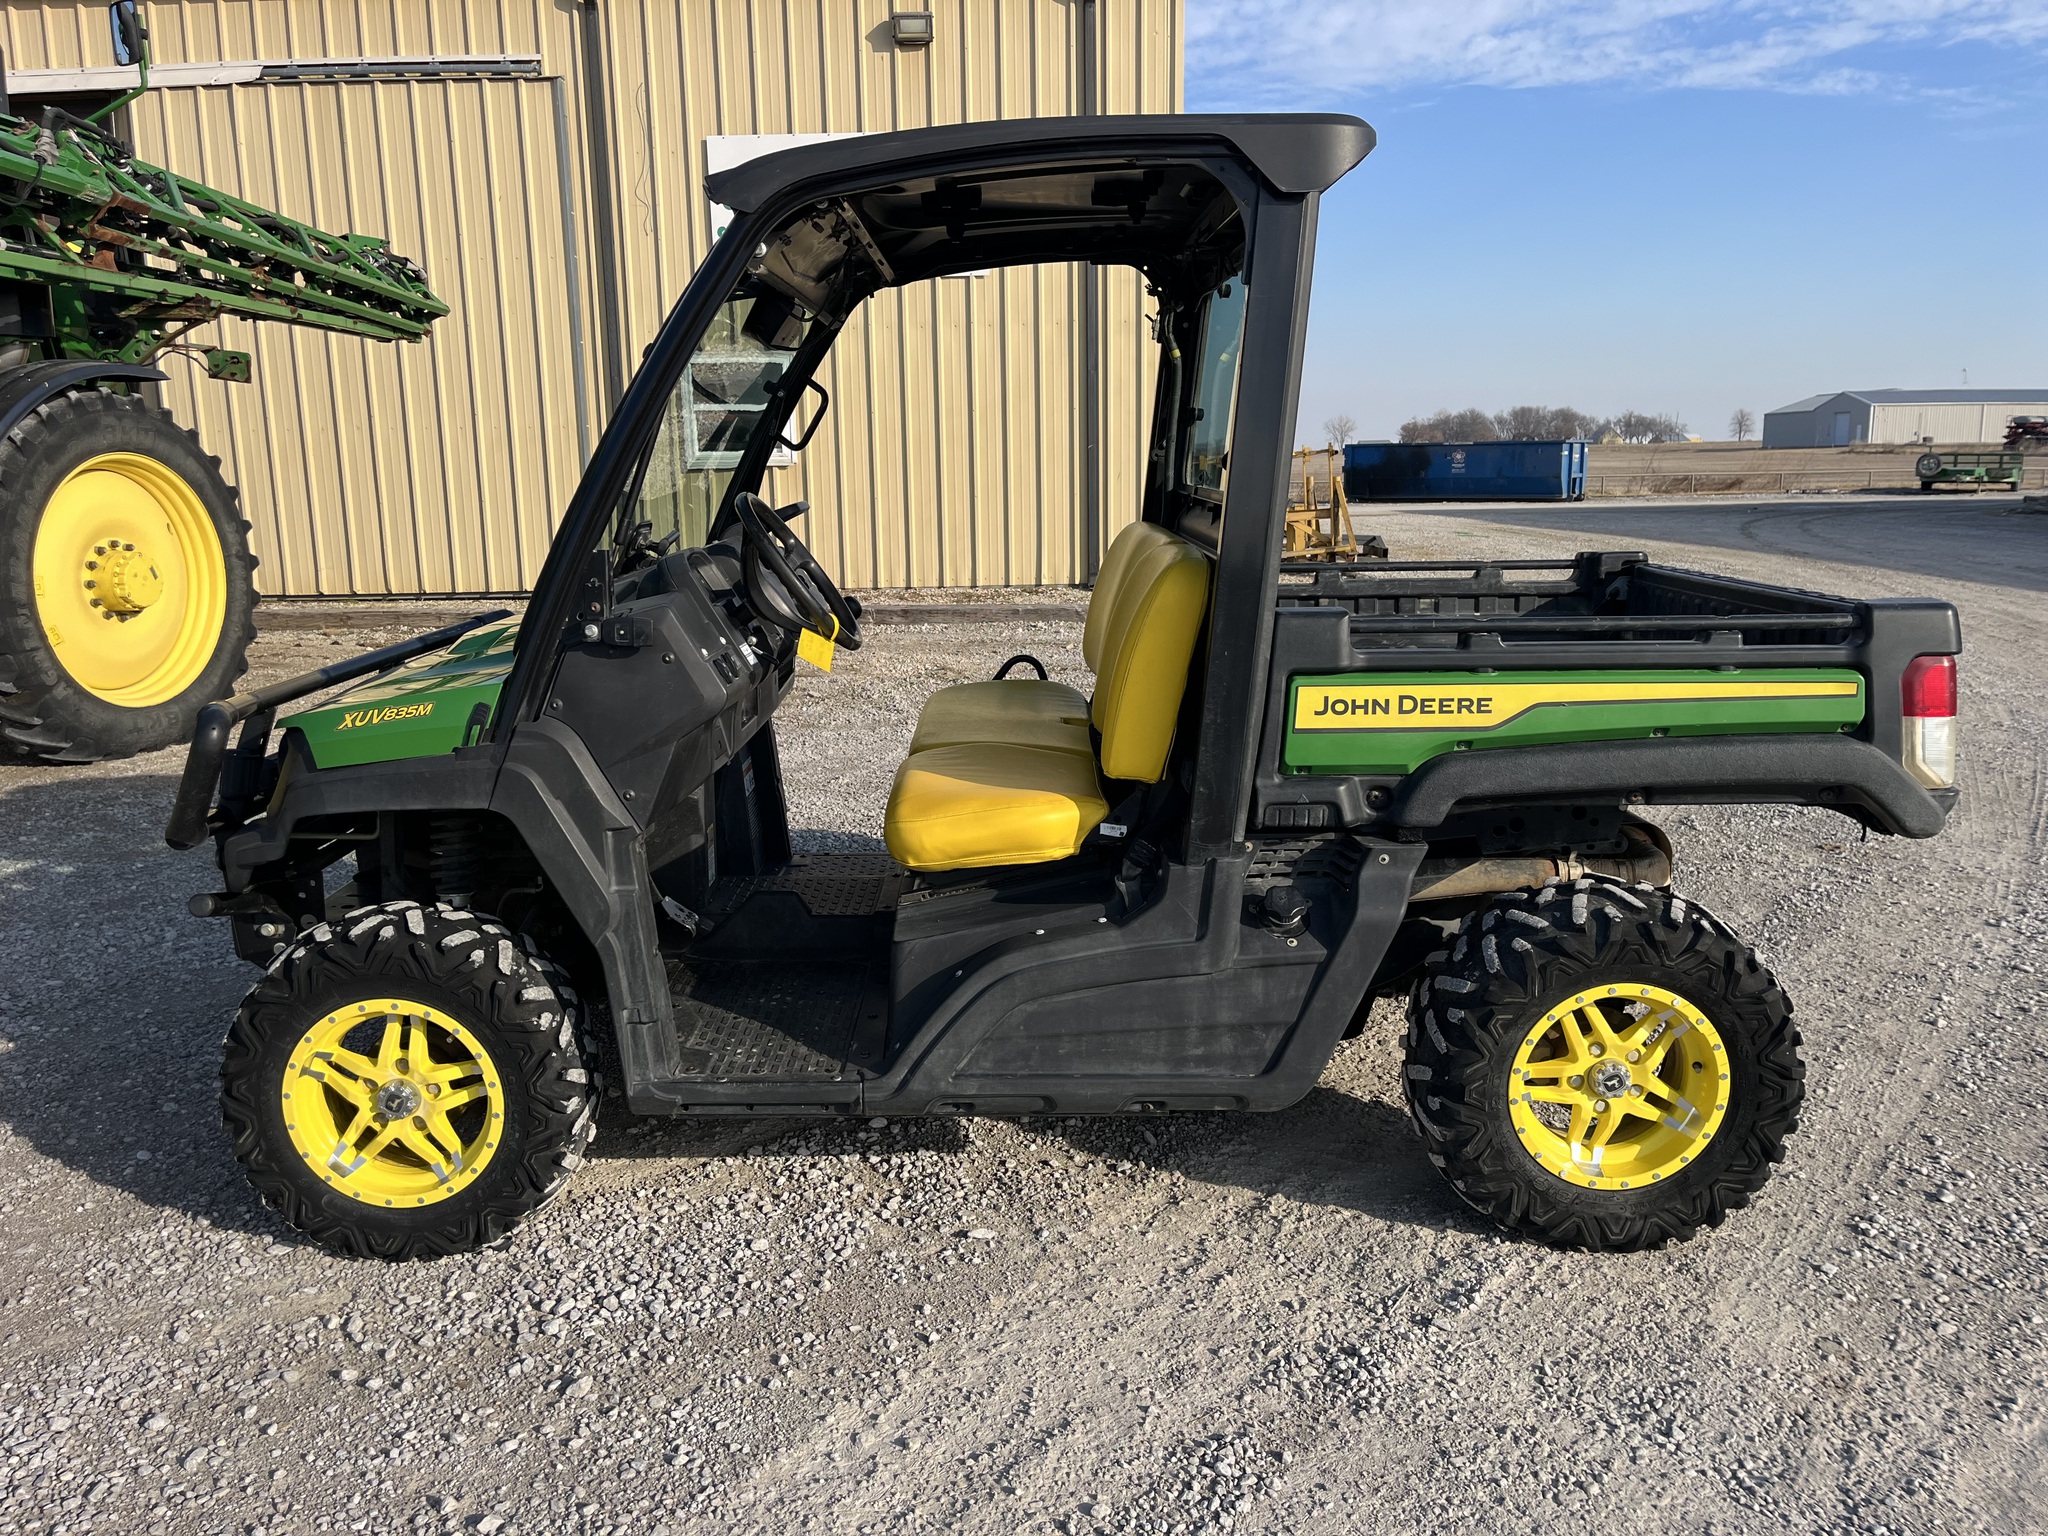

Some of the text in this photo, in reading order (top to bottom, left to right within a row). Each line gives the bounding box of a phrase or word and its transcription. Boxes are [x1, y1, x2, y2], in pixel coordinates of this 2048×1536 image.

[335, 702, 435, 731] XUV835M
[1314, 695, 1493, 716] JOHN DEERE
